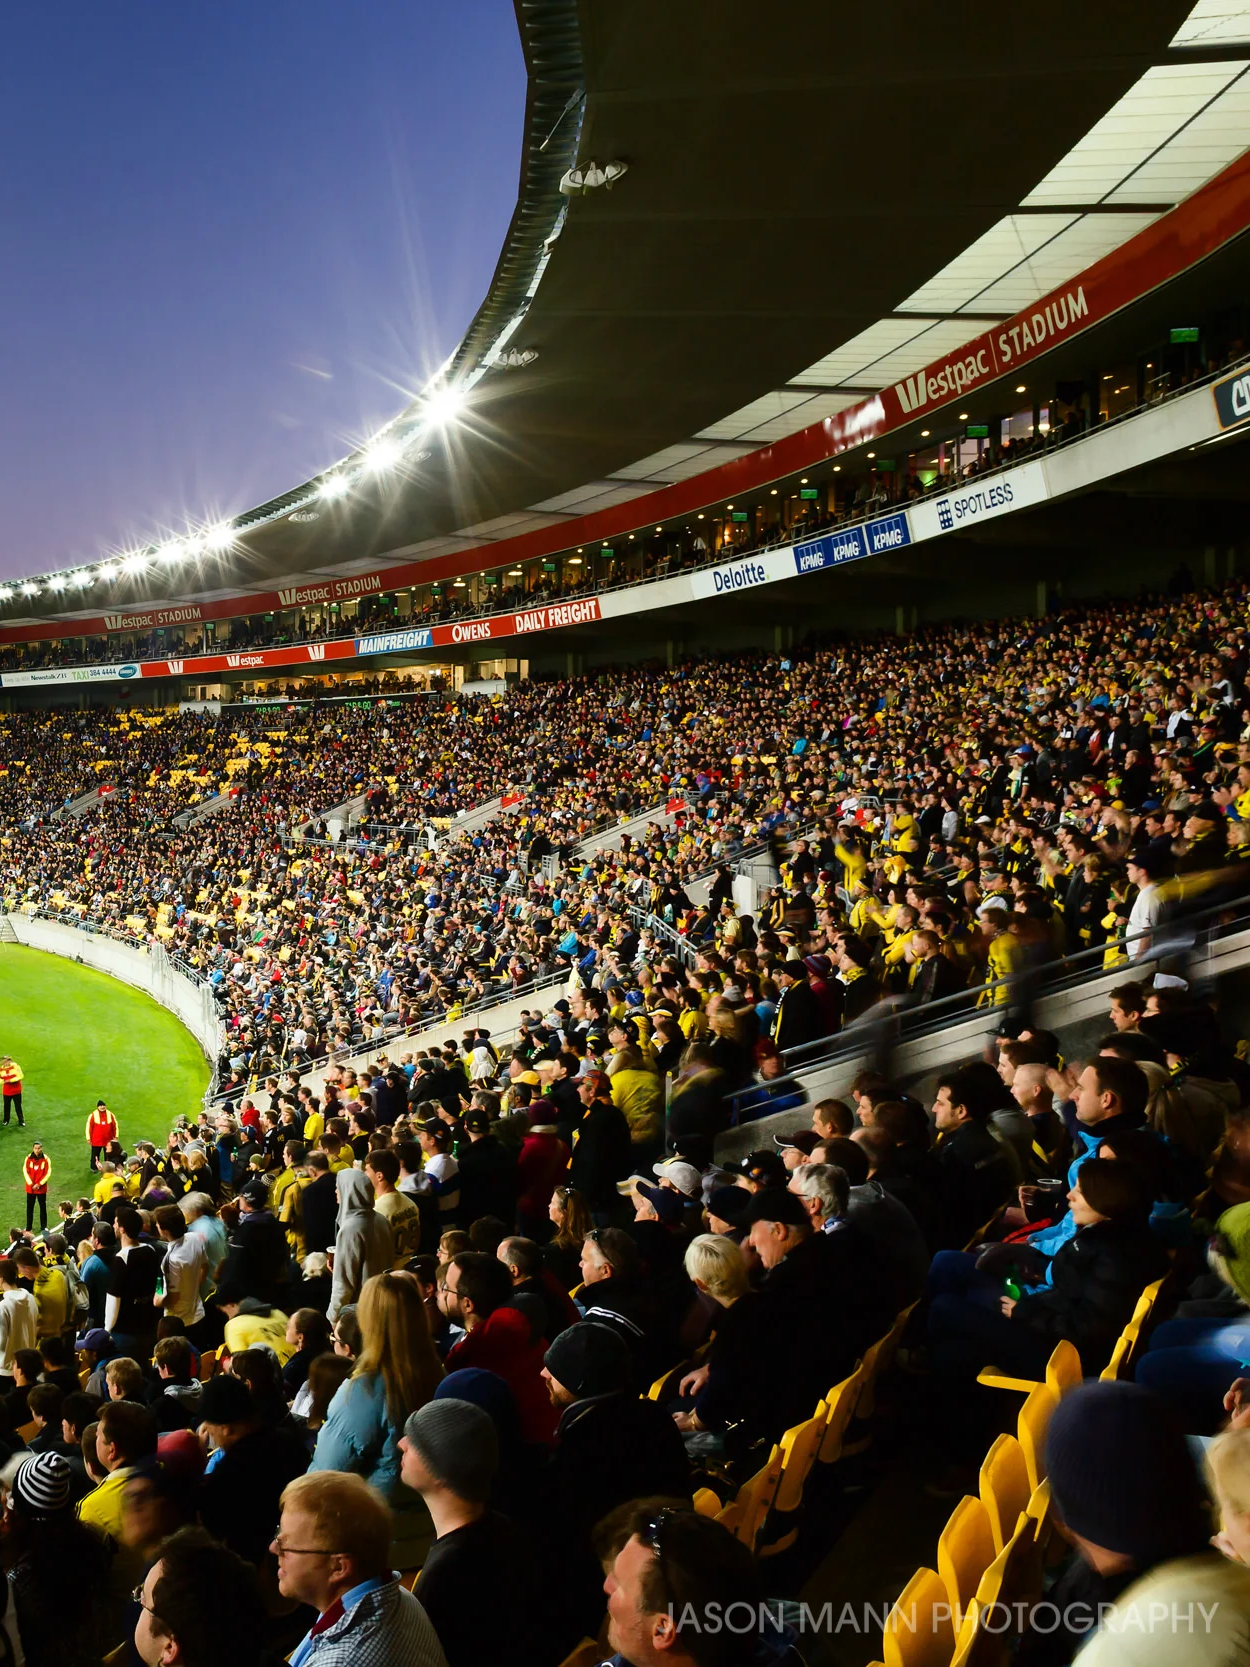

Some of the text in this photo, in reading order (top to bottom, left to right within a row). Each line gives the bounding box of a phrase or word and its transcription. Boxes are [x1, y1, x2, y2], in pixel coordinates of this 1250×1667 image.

[894, 286, 1089, 413] Westpac STADIUM
[954, 483, 1014, 519] SPOTLESS
[873, 529, 903, 550] KPMG
[800, 552, 825, 571] KPMG
[833, 541, 861, 561] KPMG
[278, 575, 381, 605] Westpac STADIUM
[104, 608, 202, 629] Westpac STADIUM
[515, 601, 597, 633] DAILY FREIGHT
[358, 630, 430, 654] MAINFREIGHT
[452, 622, 491, 642] OWENS
[227, 655, 264, 667] Westpac
[71, 671, 90, 681] TAXI
